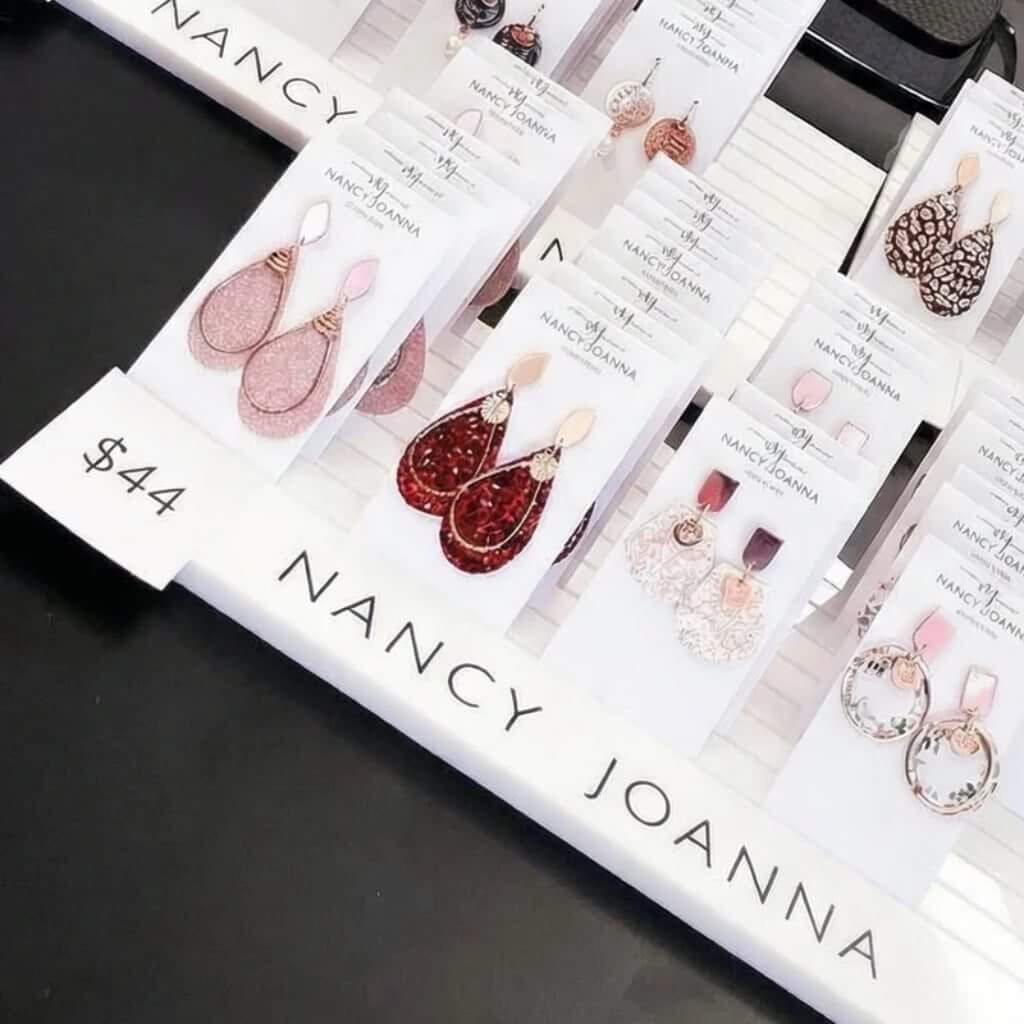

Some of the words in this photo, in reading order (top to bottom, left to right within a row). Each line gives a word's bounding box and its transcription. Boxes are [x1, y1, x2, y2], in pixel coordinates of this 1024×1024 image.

[325, 167, 368, 201] NANCY
[367, 197, 420, 238] JOANNA
[624, 239, 665, 271] NANCY
[540, 311, 587, 345] NANCY
[584, 342, 637, 382] JOANNA
[814, 338, 856, 367] NANCY
[83, 436, 186, 516] $44
[721, 432, 768, 466] NANCY
[766, 462, 818, 504] JOANNA
[978, 445, 1017, 474] NANCY
[953, 519, 998, 552] NANCY
[936, 573, 982, 607] NANCY
[278, 550, 543, 731] NANCY
[584, 757, 877, 979] JOANNA
